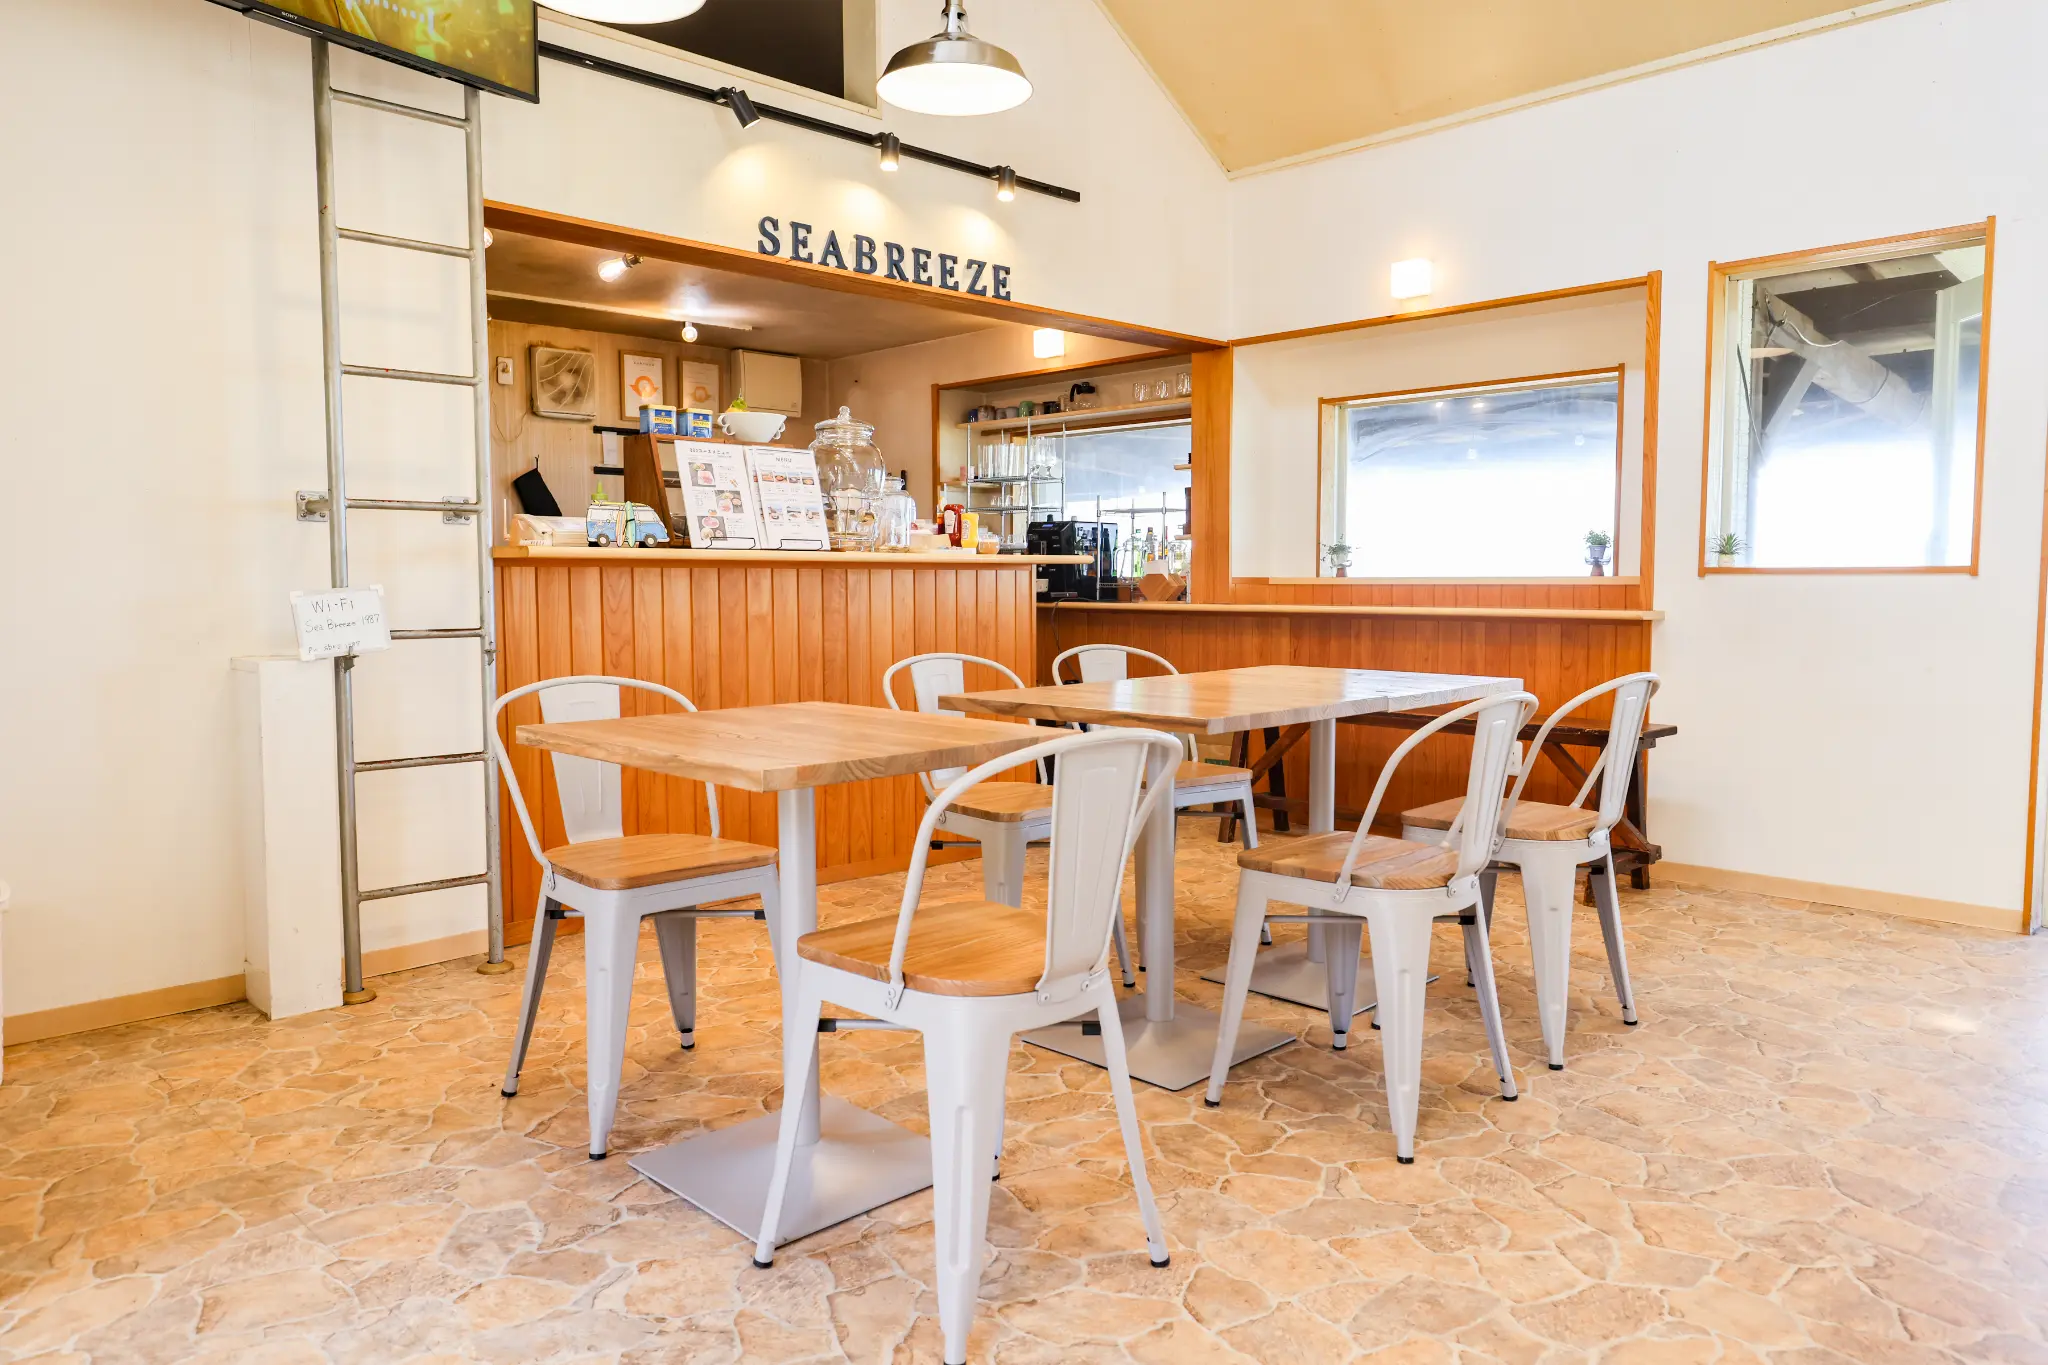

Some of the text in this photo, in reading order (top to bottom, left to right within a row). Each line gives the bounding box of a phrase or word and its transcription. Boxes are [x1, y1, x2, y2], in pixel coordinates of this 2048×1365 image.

[281, 11, 298, 20] SONY
[757, 215, 1011, 301] SEABREEZE
[311, 597, 354, 613] Wi-Fi
[305, 613, 380, 633] Sea Breeze 1987
